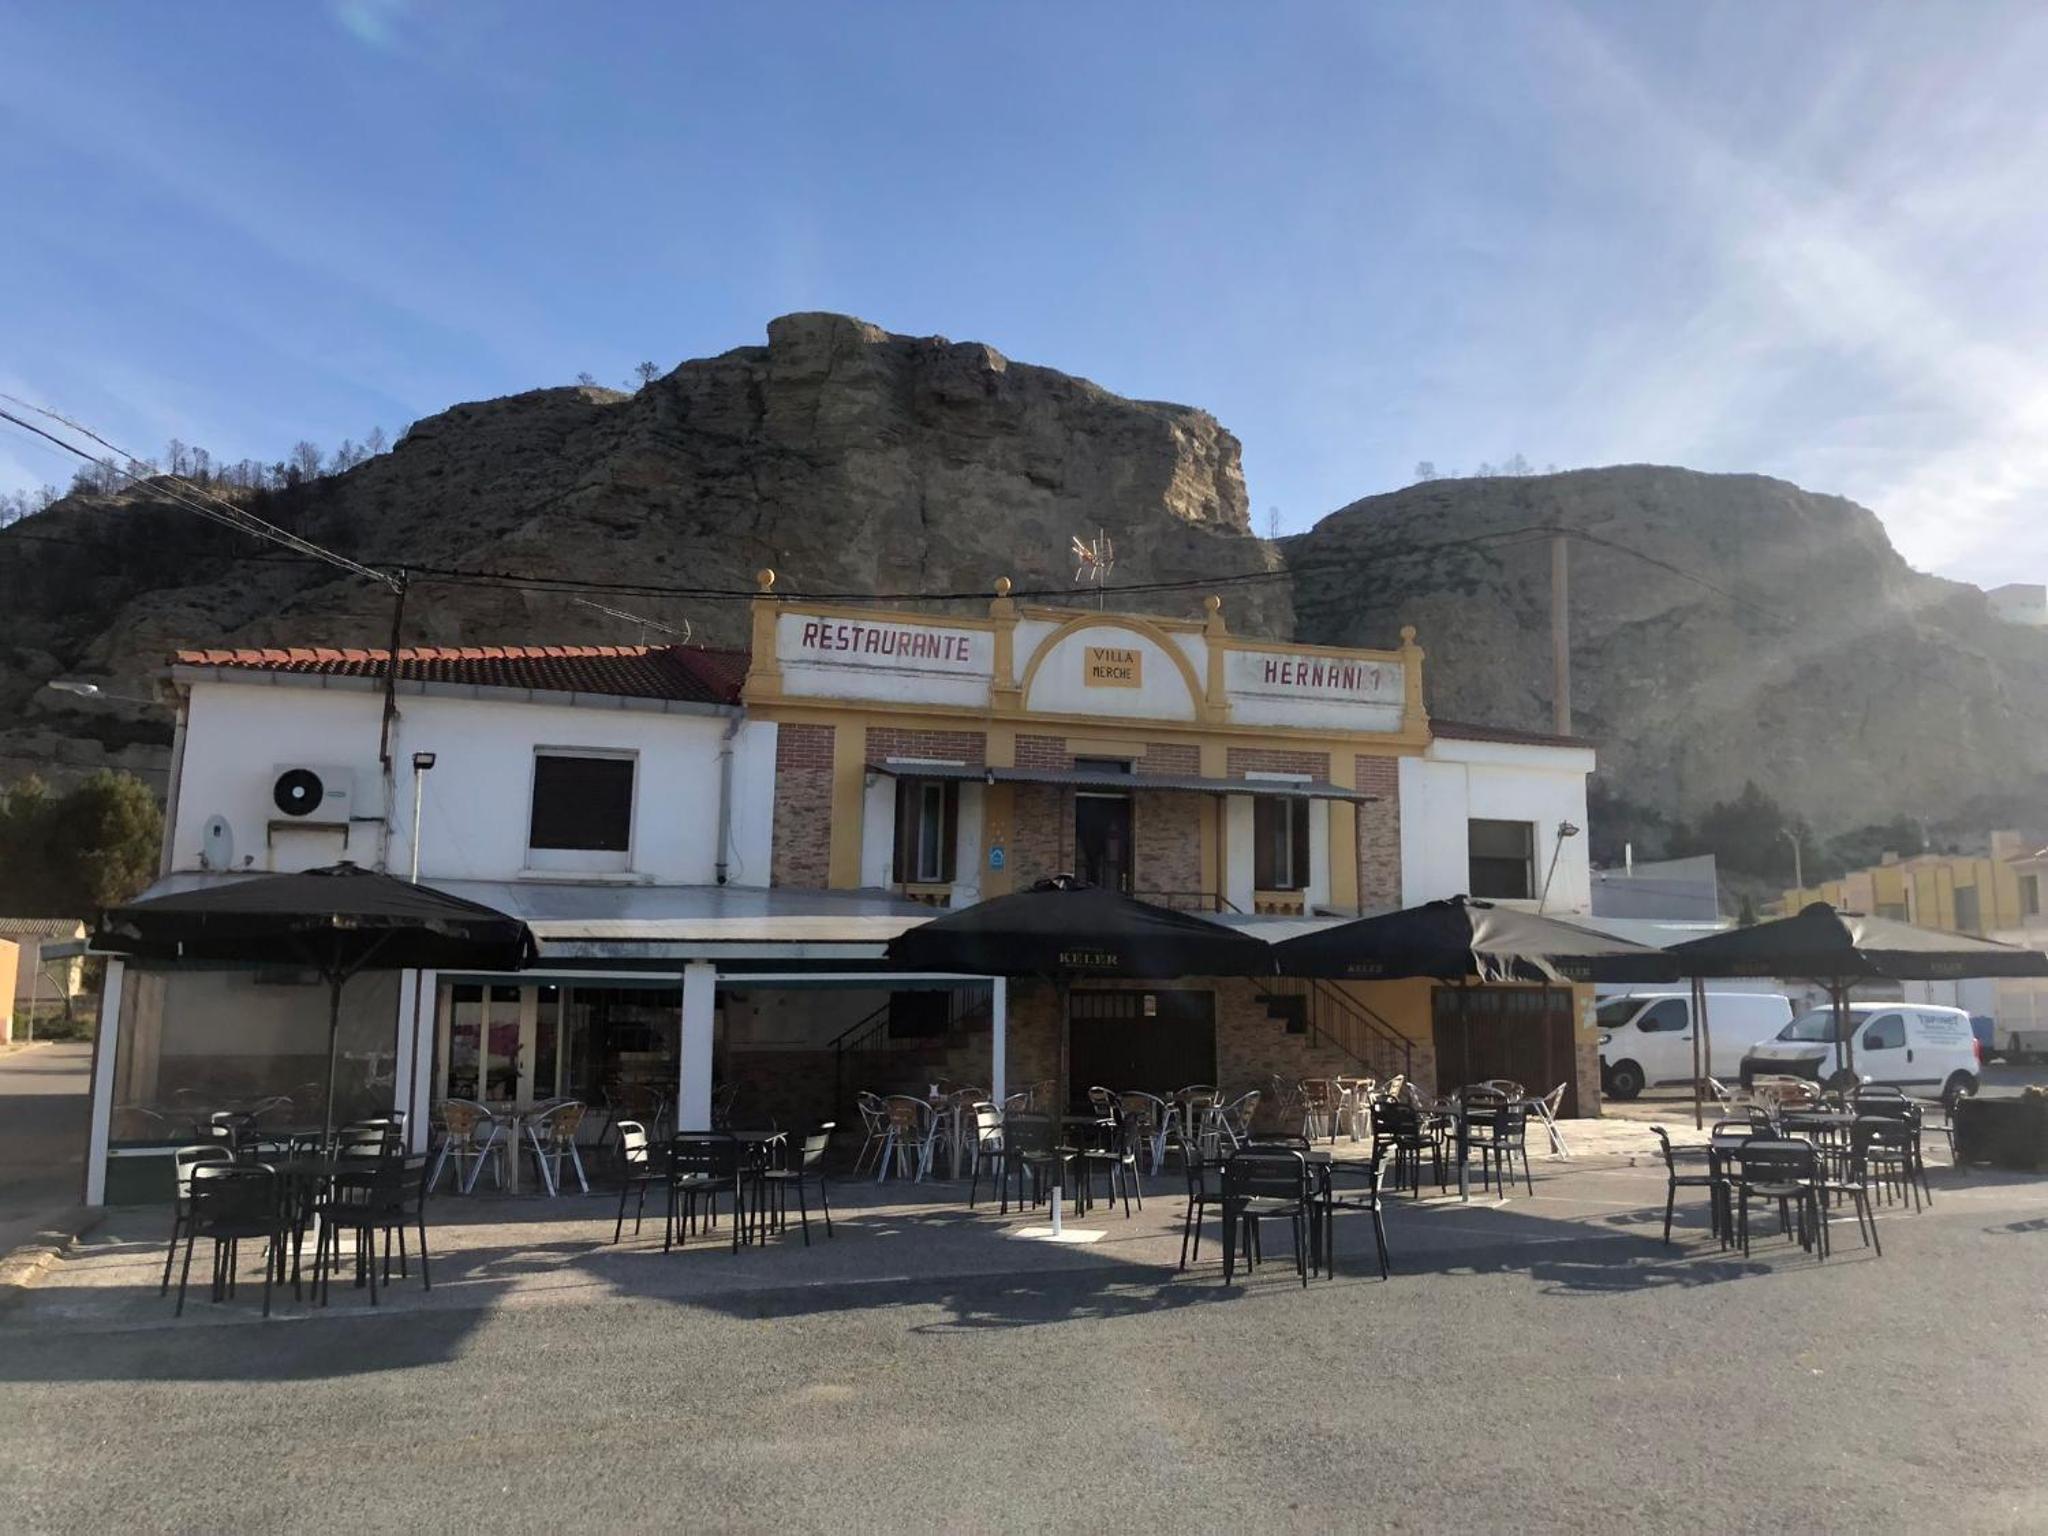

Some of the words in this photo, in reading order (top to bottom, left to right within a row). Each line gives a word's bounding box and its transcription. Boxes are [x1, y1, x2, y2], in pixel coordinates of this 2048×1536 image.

[803, 622, 970, 661] RESTAURANTE
[1093, 648, 1134, 663] VILLA
[1093, 666, 1132, 679] MERCHE
[1264, 660, 1363, 690] HERNANI
